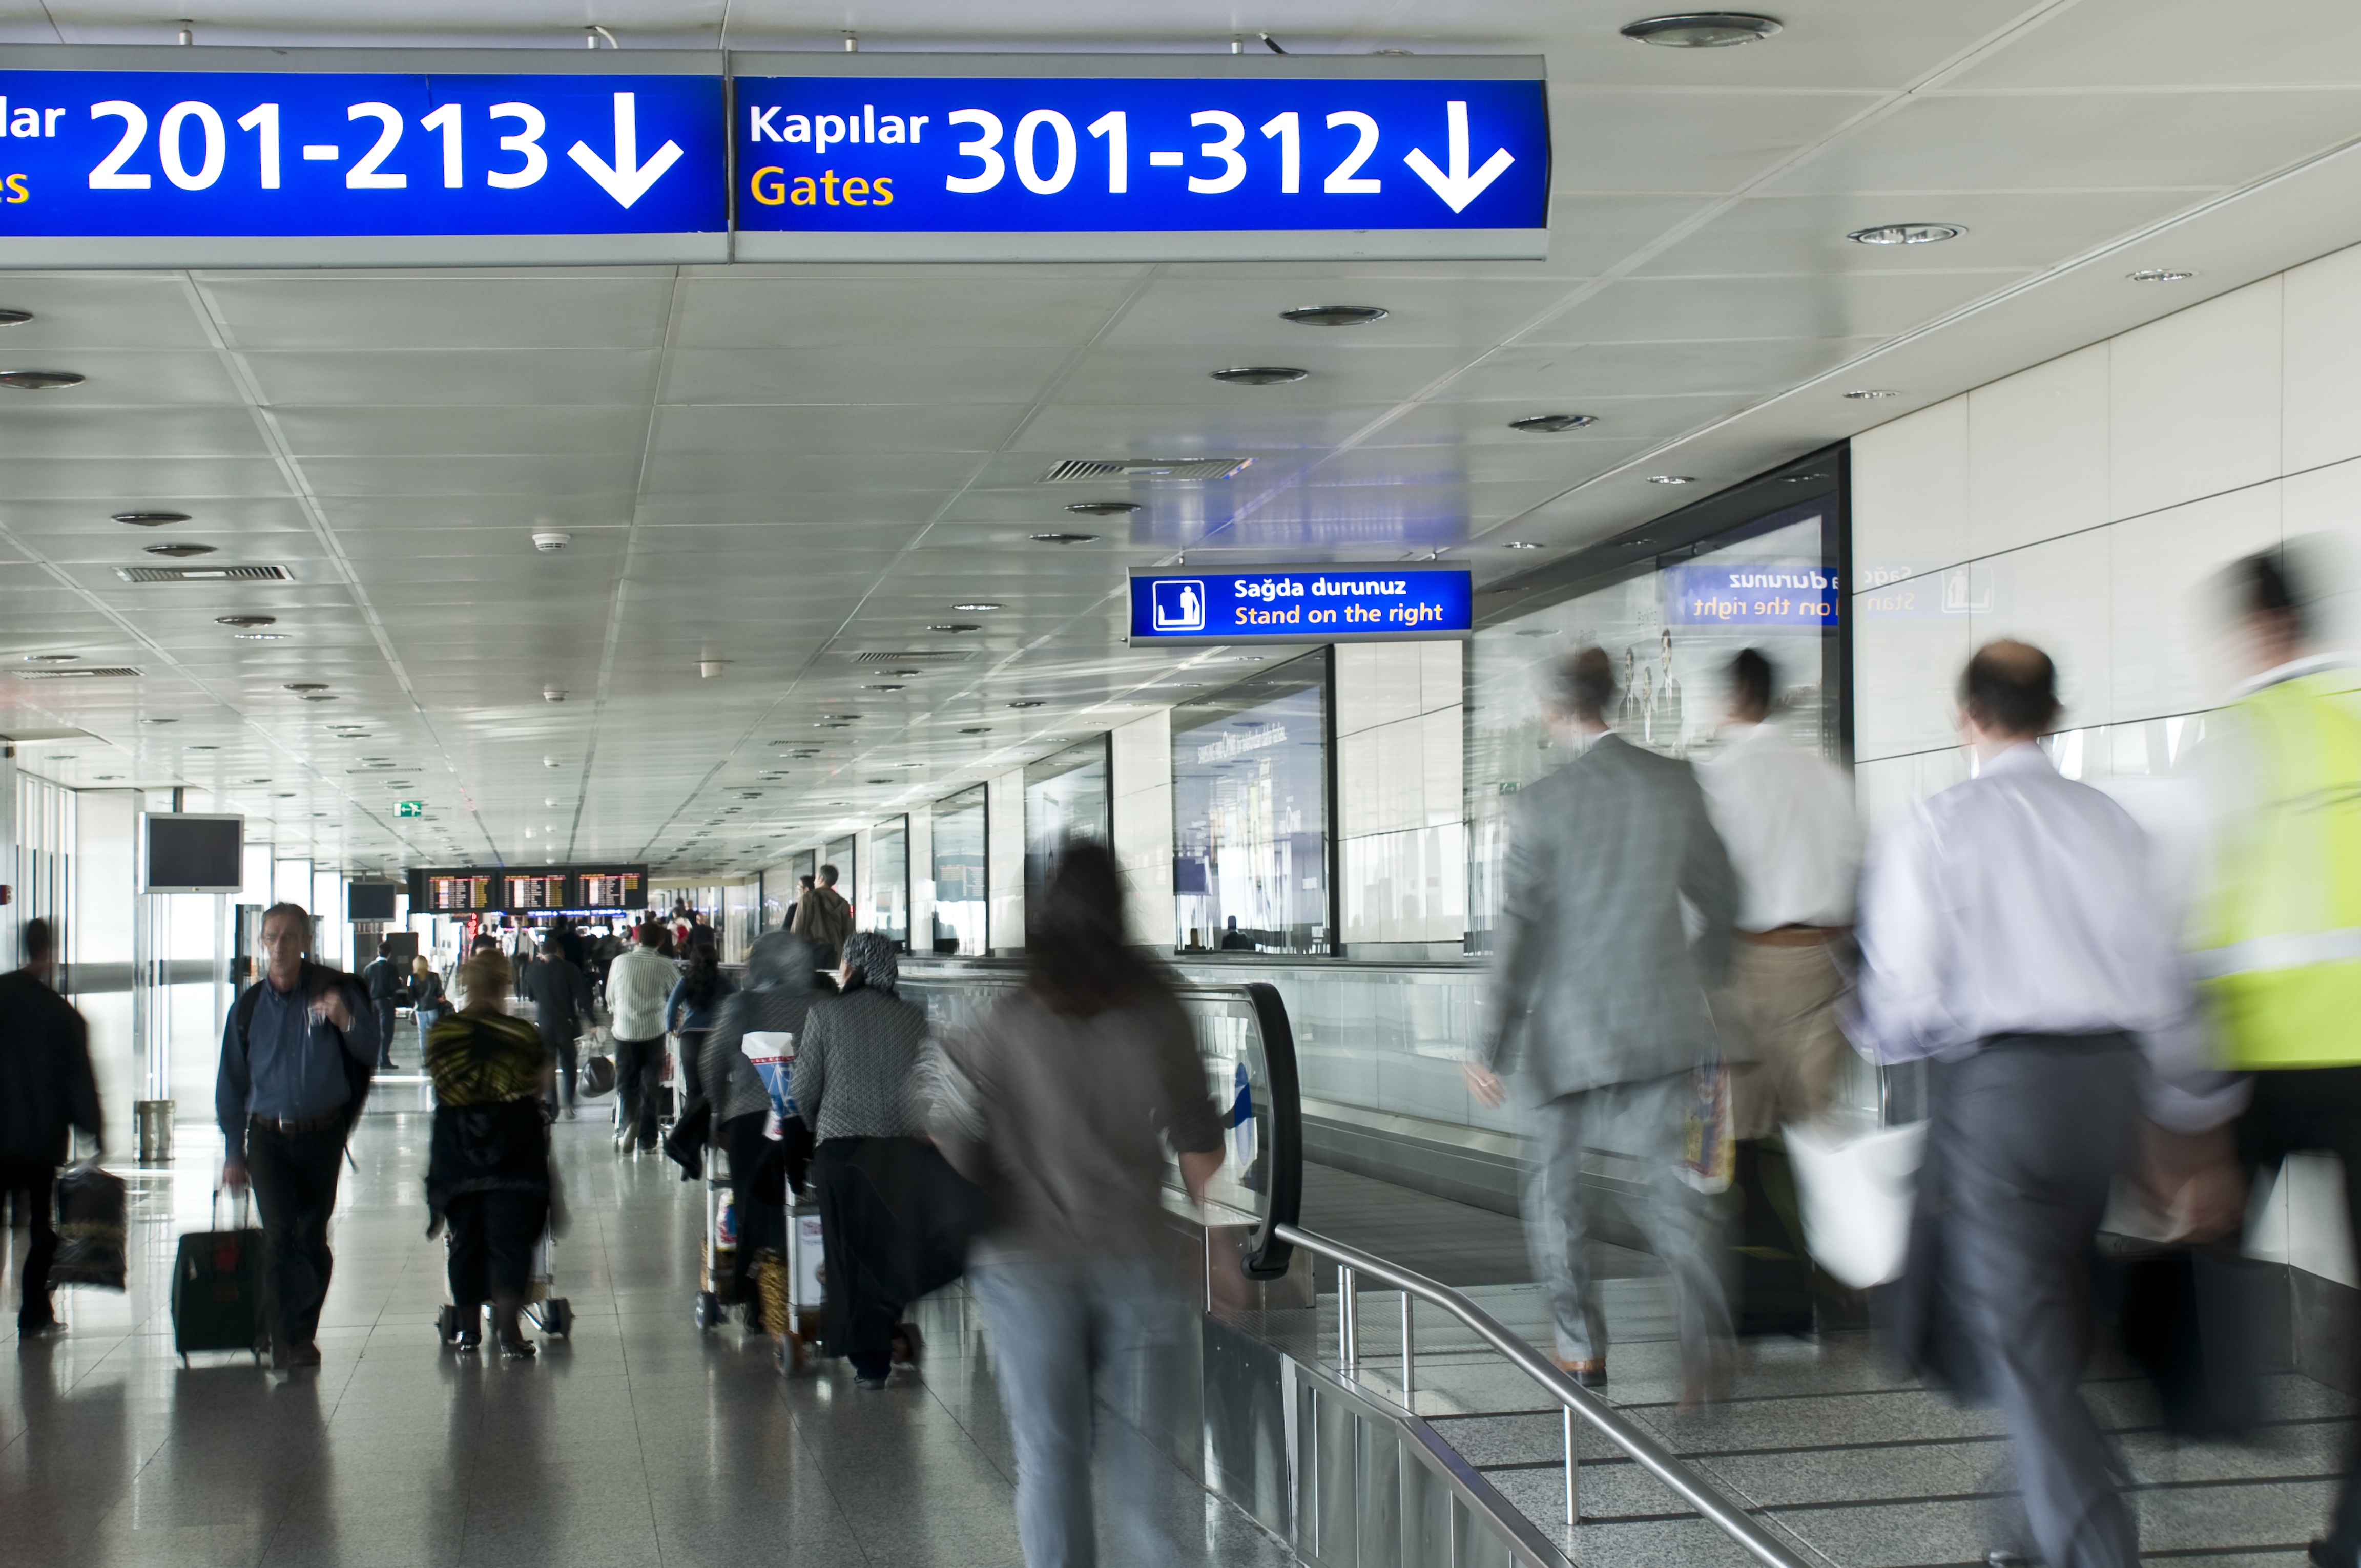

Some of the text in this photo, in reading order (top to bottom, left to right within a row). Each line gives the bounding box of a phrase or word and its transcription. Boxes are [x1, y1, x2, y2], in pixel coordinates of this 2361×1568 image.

[88, 100, 548, 192] 201-213
[751, 104, 930, 154] Kapılar
[946, 108, 1382, 195] 301-312
[751, 166, 894, 206] Gates
[1234, 577, 1407, 602] Sağda durunuz
[1234, 602, 1444, 626] Stand on the right
